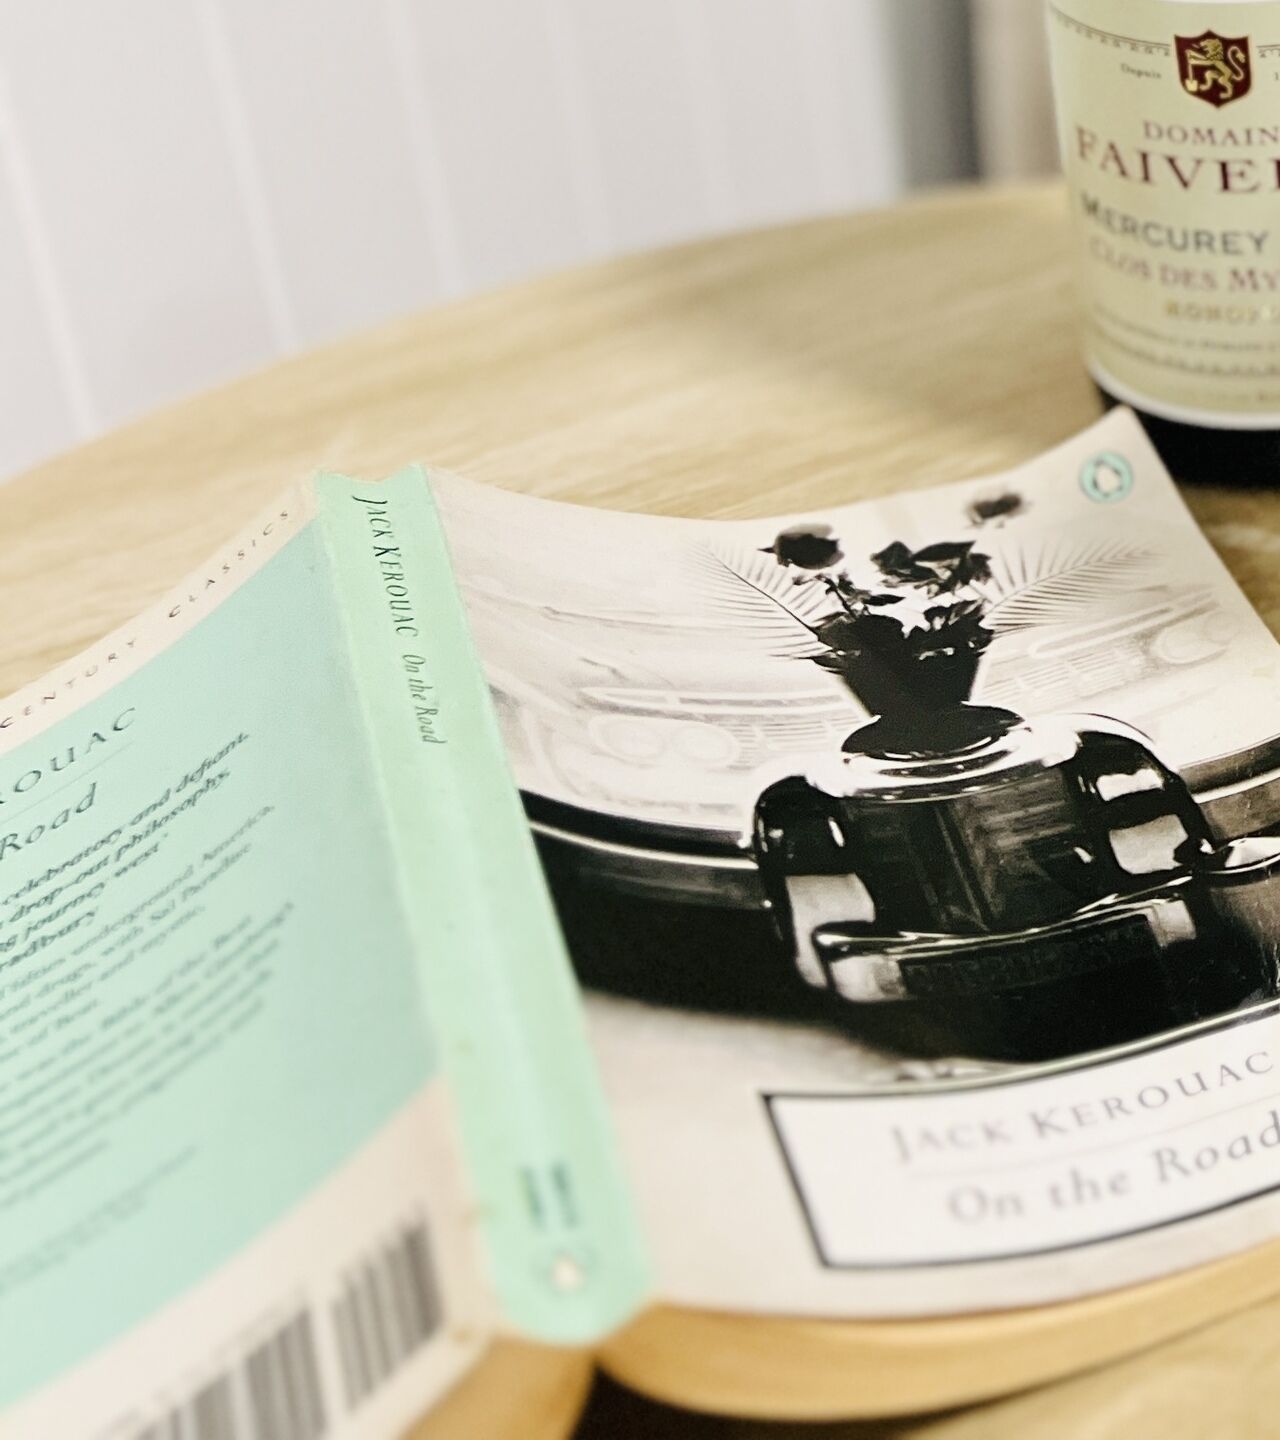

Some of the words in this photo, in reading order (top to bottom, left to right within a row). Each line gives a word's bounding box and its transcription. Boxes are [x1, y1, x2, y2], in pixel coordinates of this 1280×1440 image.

[1080, 193, 1269, 256] MERCUREY
[169, 510, 288, 618] CLASSICS
[352, 494, 394, 539] JACK
[373, 545, 419, 637] KEROUAC
[415, 703, 447, 744] Road
[0, 707, 135, 806] OUAC
[129, 789, 170, 826] and
[1030, 1051, 1275, 1140] KEROUAC
[1050, 1167, 1131, 1210] the
